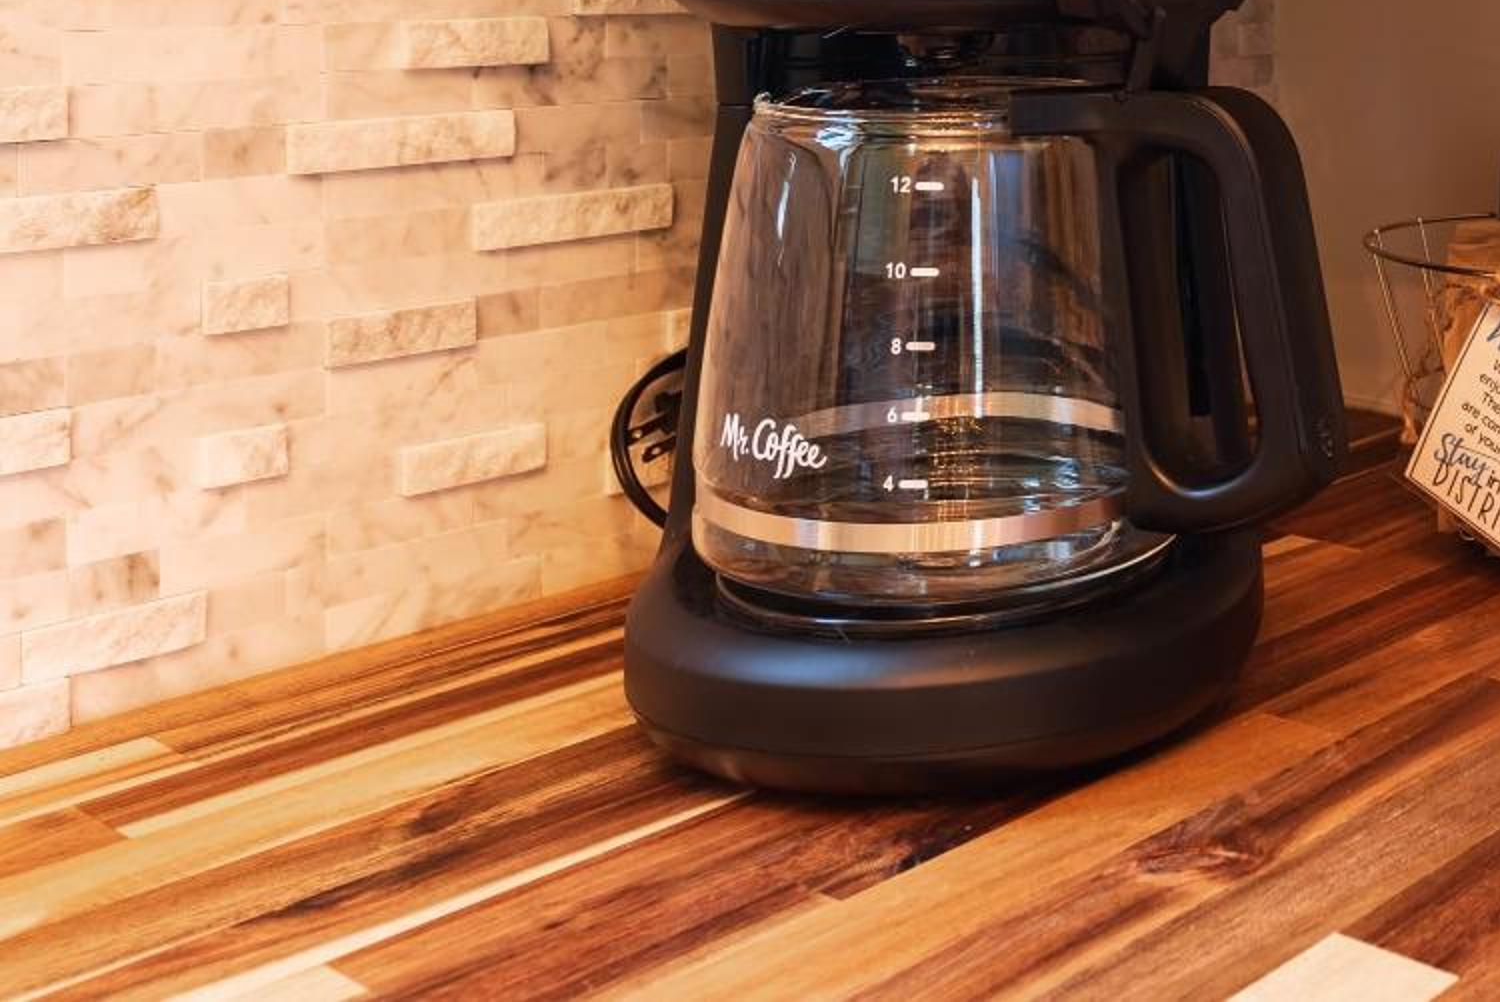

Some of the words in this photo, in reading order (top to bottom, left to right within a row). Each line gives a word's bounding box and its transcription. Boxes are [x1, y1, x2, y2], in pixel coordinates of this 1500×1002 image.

[892, 177, 911, 193] 12
[886, 263, 906, 278] 10
[891, 338, 902, 355] 8
[887, 409, 897, 424] 6
[1461, 402, 1480, 419] are
[1464, 423, 1478, 434] of
[720, 414, 749, 461] Mr.
[752, 418, 827, 479] Coffee
[1434, 433, 1490, 486] Stay
[883, 476, 894, 492] 4
